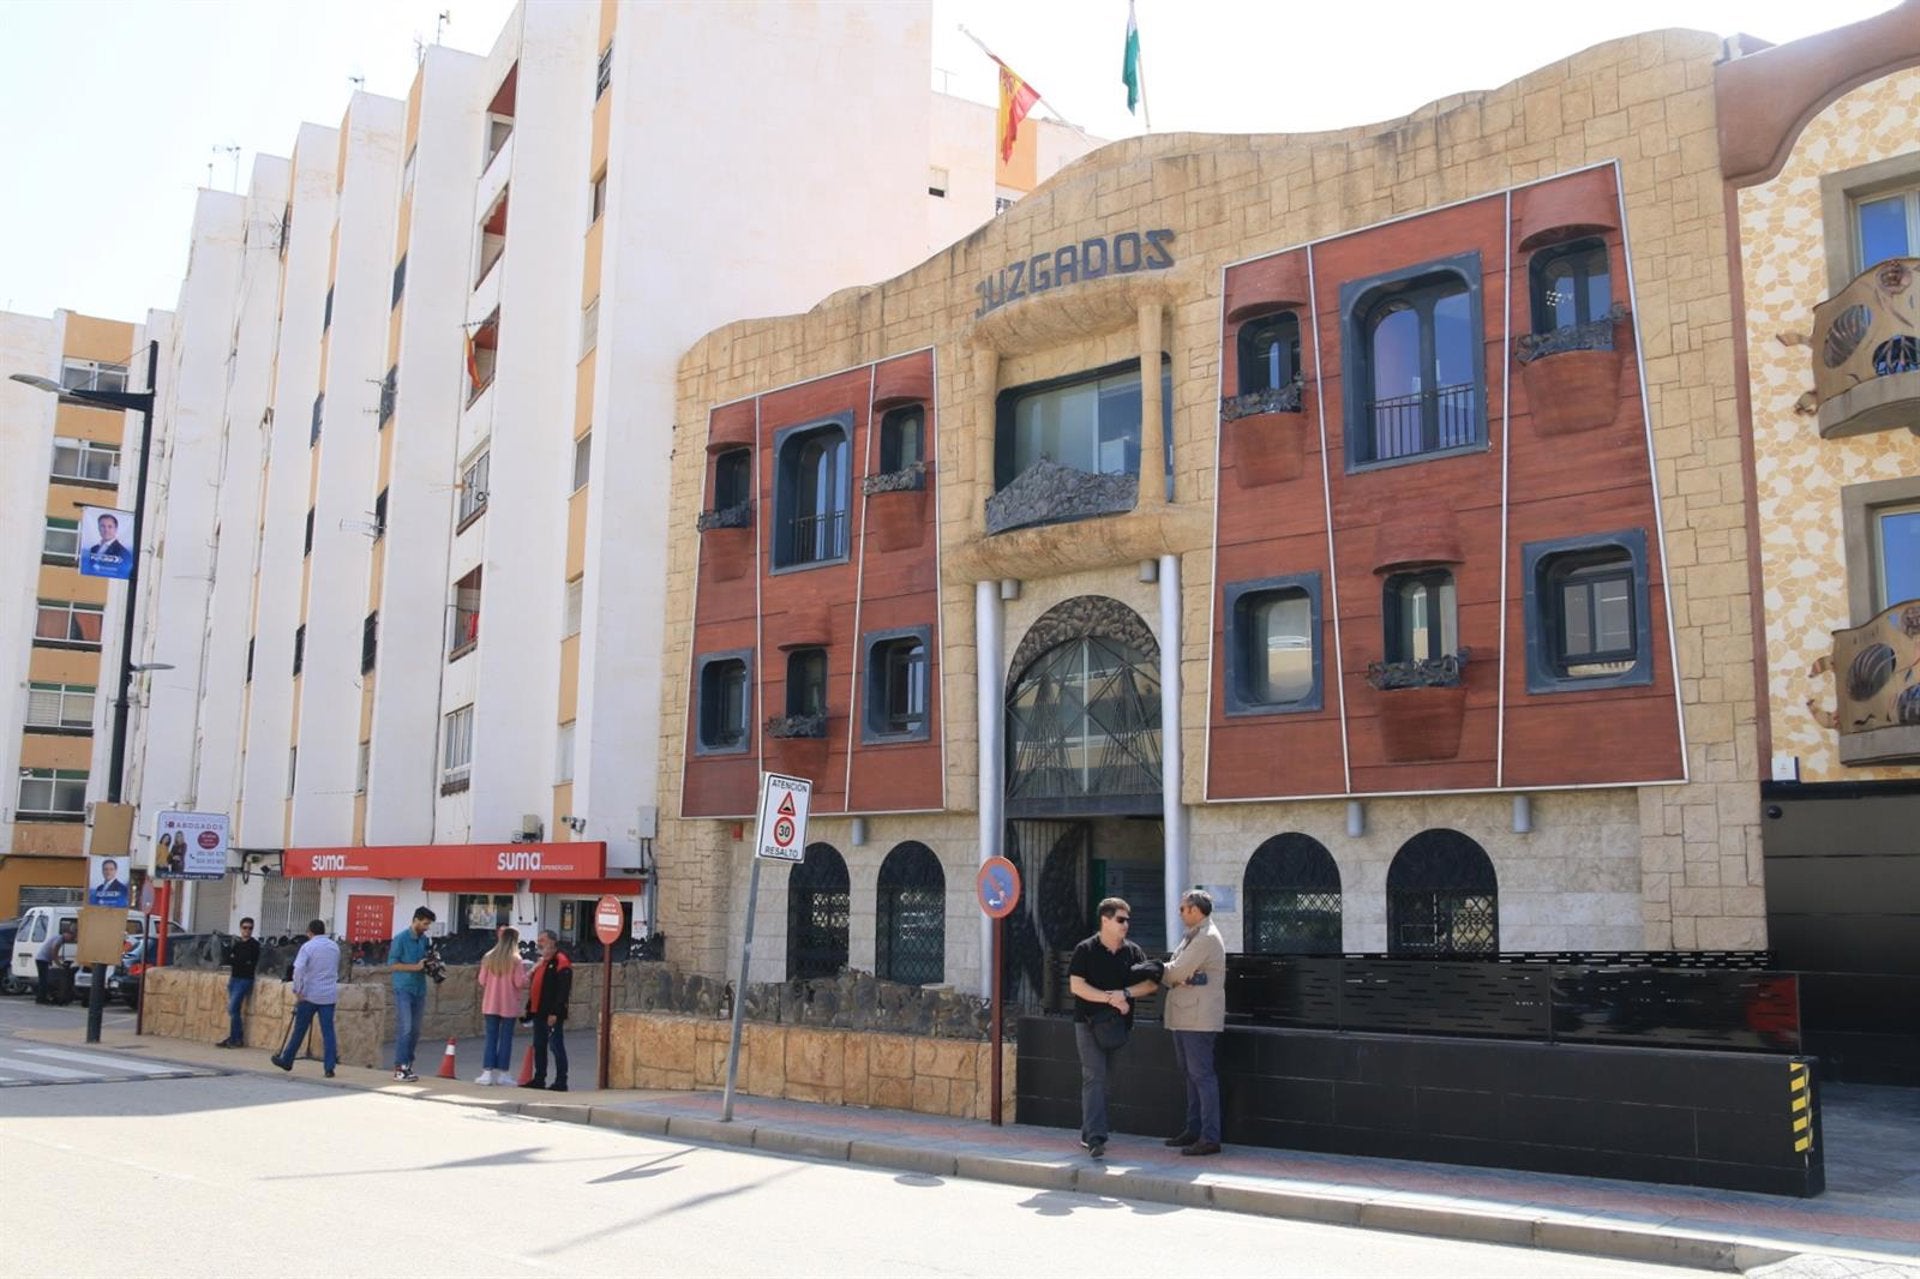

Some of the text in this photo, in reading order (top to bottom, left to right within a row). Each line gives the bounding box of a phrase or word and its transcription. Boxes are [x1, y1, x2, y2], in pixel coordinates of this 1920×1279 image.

[975, 229, 1176, 319] JUZGADOS
[778, 825, 791, 838] 30
[765, 846, 799, 858] RESALTO
[311, 854, 344, 871] suma
[497, 852, 541, 870] suma
